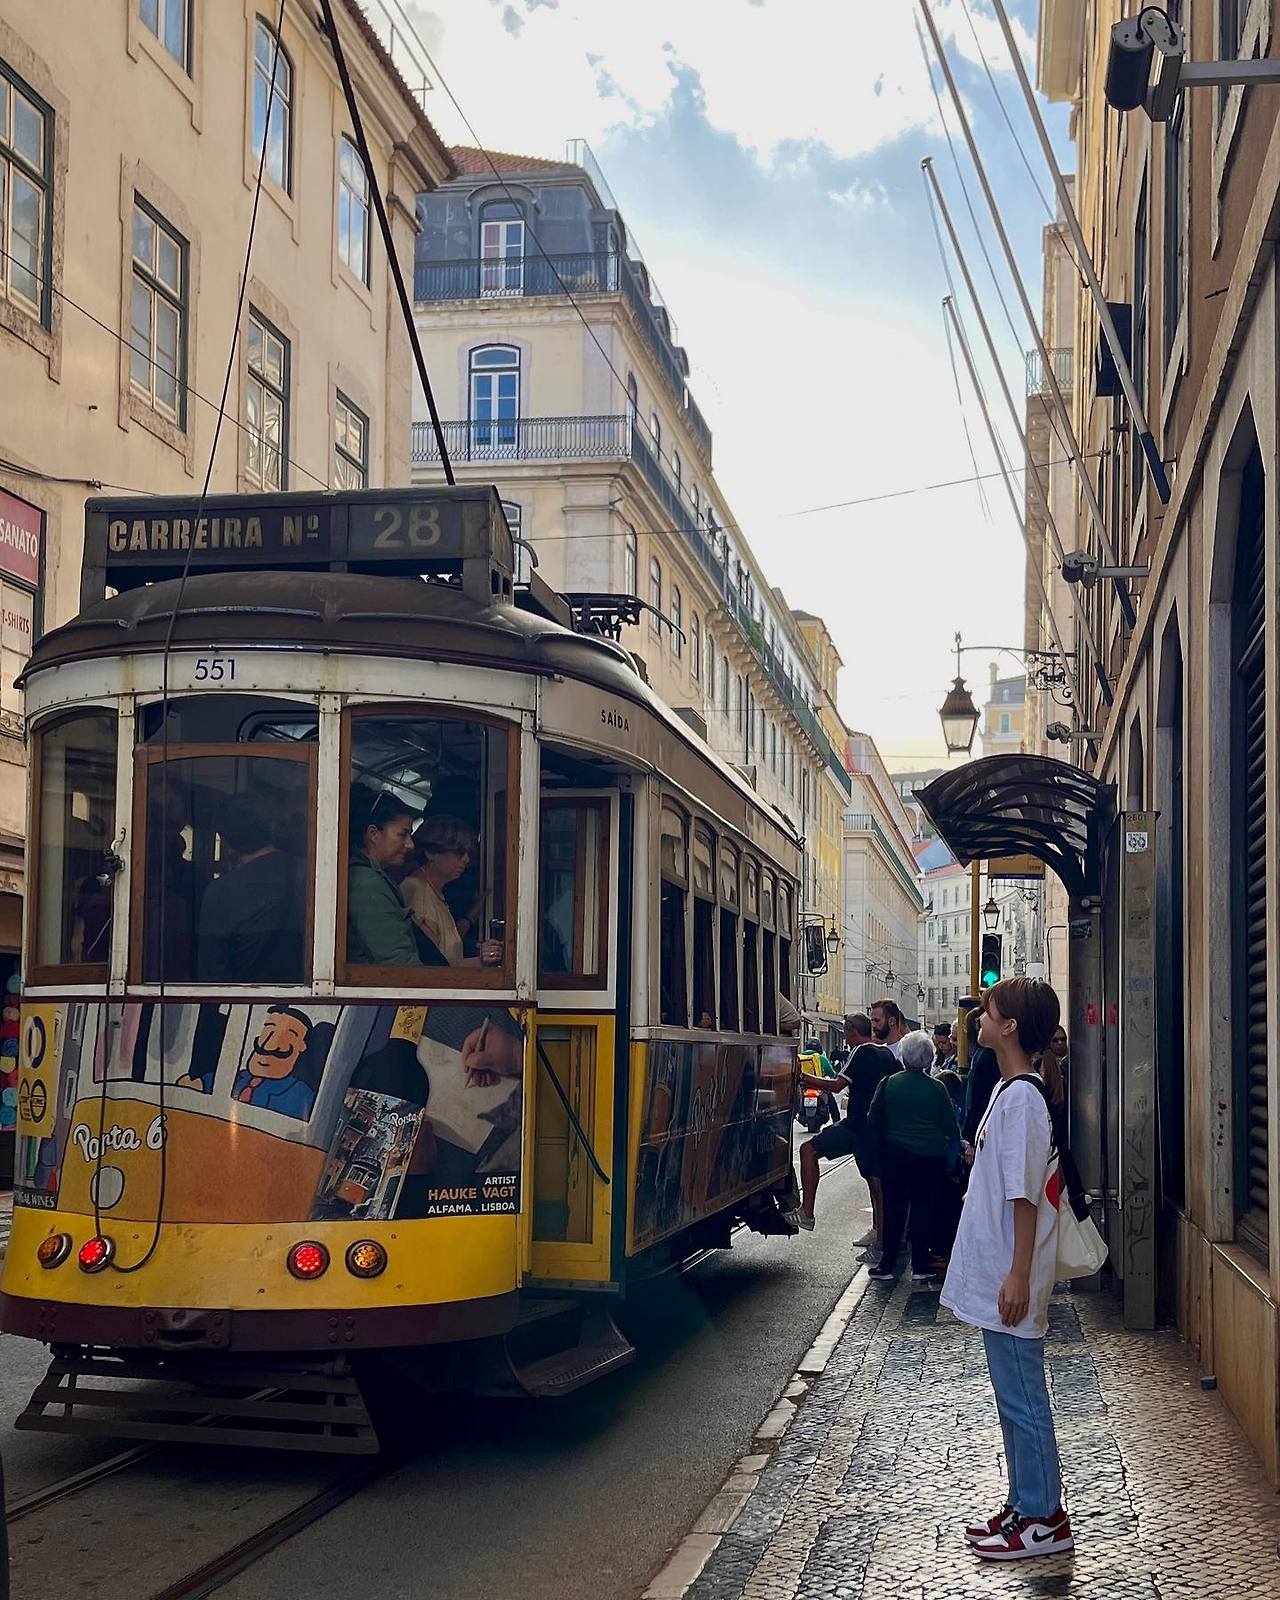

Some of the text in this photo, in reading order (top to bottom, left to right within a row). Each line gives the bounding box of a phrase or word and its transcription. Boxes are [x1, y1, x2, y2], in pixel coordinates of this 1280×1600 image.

[109, 517, 263, 552] CARREIRA
[373, 505, 442, 548] 28
[2, 608, 30, 634] T-SHIRTS
[194, 659, 235, 680] 551
[389, 1112, 417, 1127] Porta
[73, 1114, 168, 1163] Porta 6
[484, 1175, 517, 1186] ARTIST
[428, 1186, 516, 1201] HAUKE VAGT
[427, 1203, 473, 1215] ALFAMA
[481, 1202, 516, 1212] LISBOA
